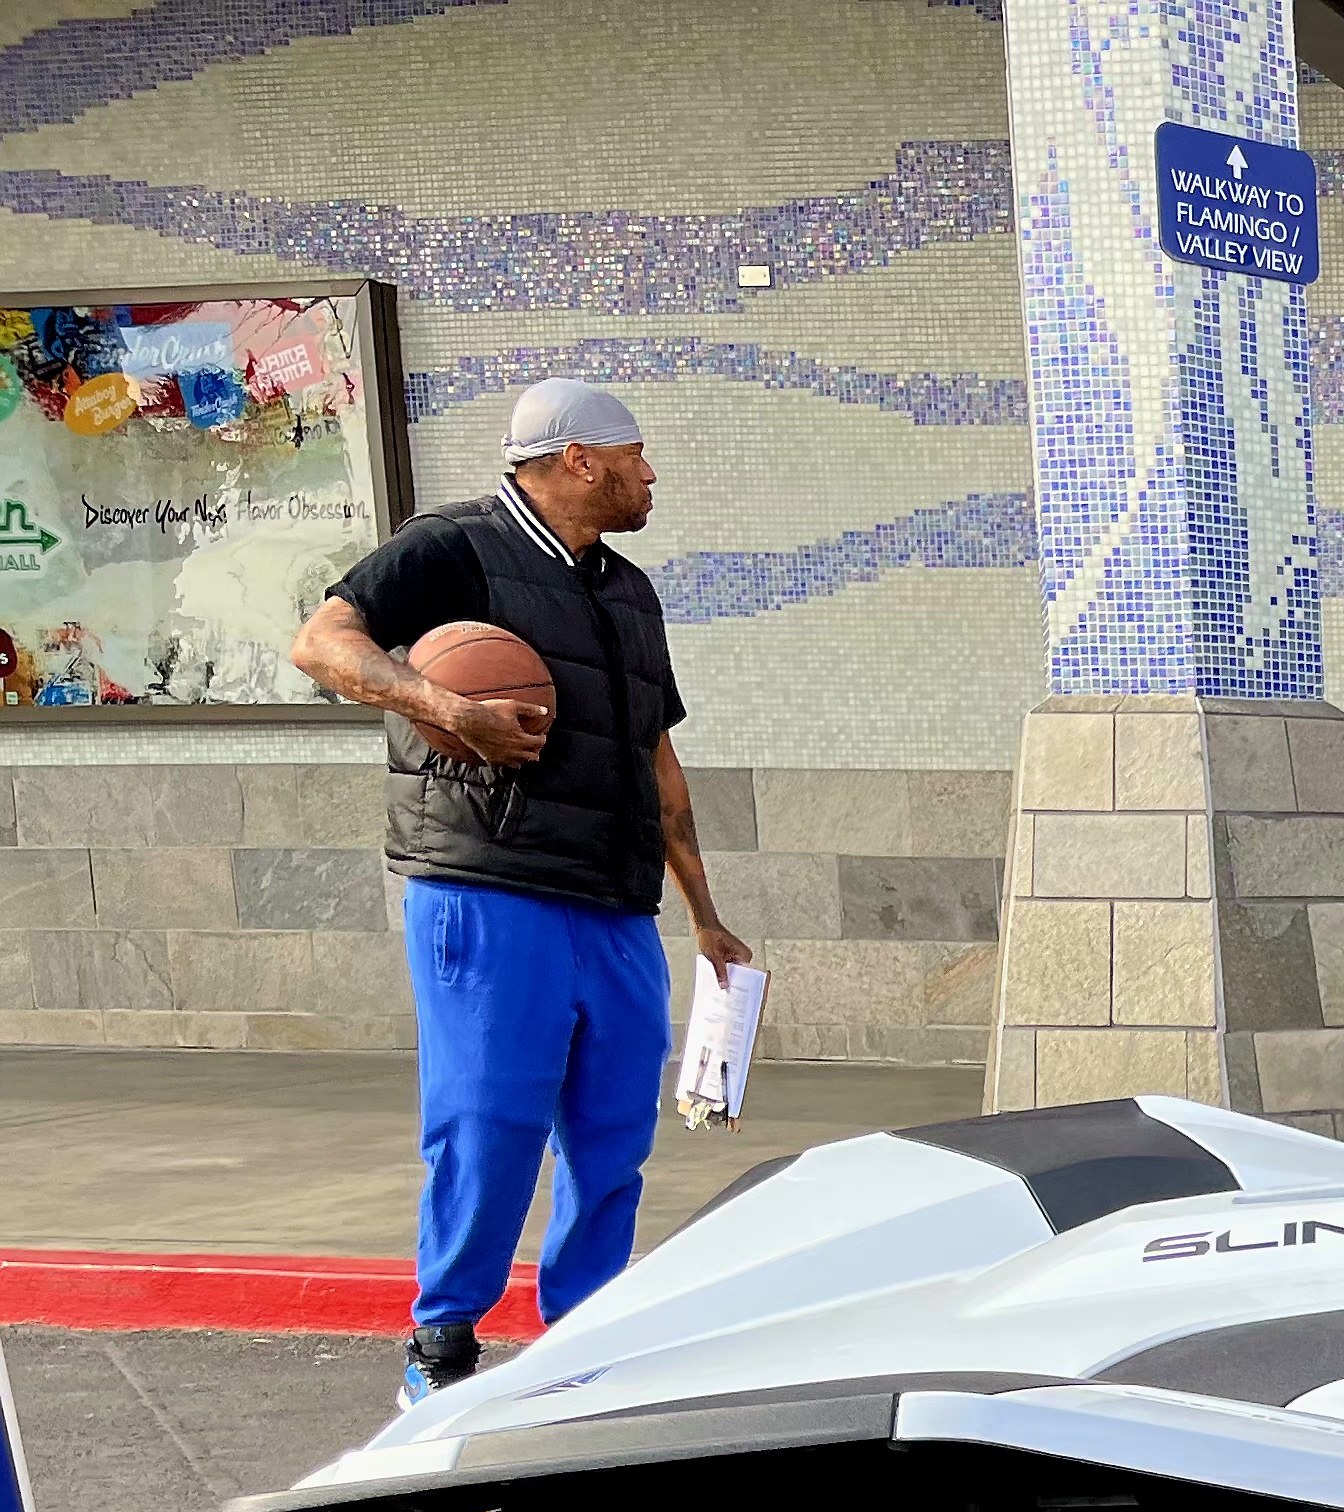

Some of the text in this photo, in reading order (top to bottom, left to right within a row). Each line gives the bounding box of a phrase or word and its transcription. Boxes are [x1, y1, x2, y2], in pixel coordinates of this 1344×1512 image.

[1171, 167, 1304, 216] WALKWAY TO
[1177, 201, 1300, 248] FLAMINGO /
[1176, 230, 1303, 275] VALLEY VIEW
[81, 494, 150, 530] Discover
[155, 499, 191, 533] Your
[236, 490, 284, 521] Flavor
